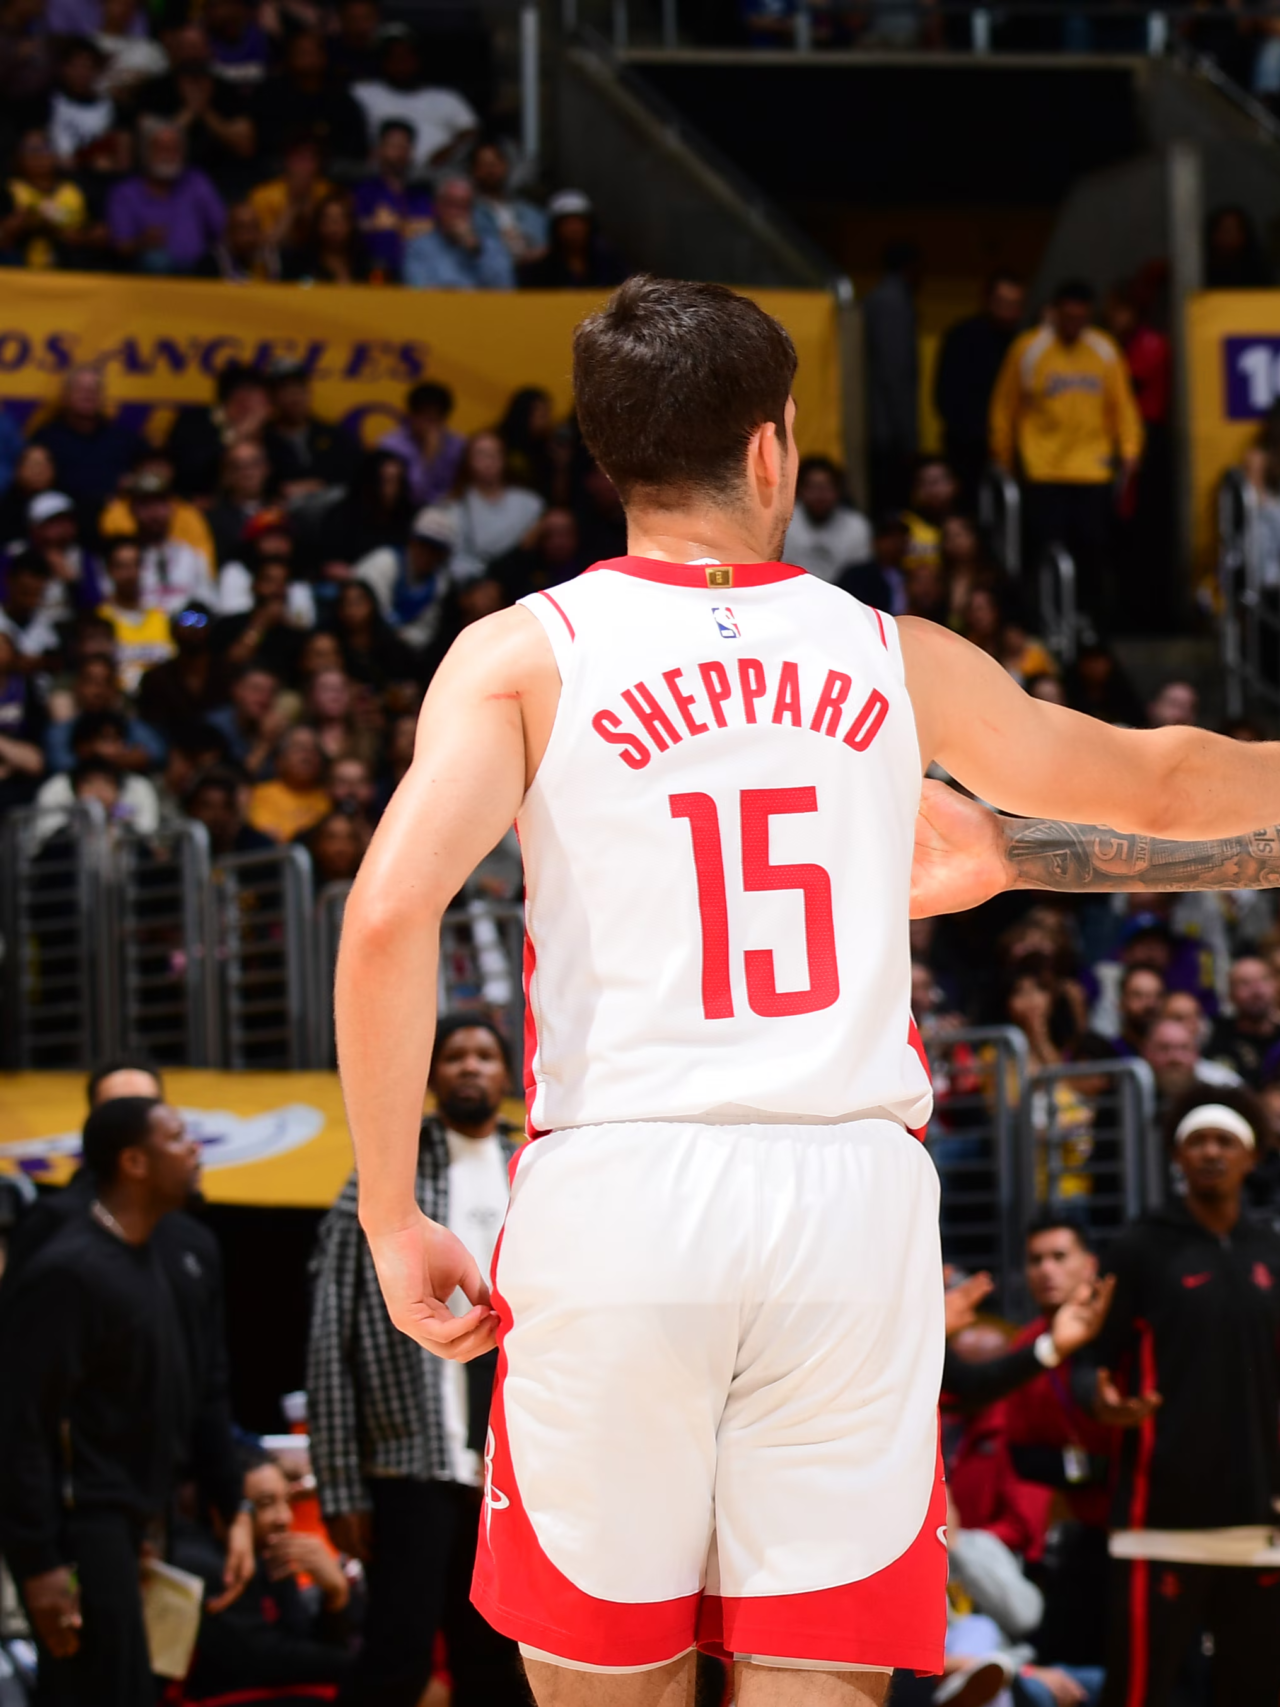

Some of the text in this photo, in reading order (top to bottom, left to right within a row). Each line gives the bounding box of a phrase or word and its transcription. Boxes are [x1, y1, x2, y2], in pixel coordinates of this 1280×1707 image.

[98, 334, 432, 382] ANGELES
[591, 658, 889, 770] SHEPPARD
[668, 786, 840, 1020] 15
